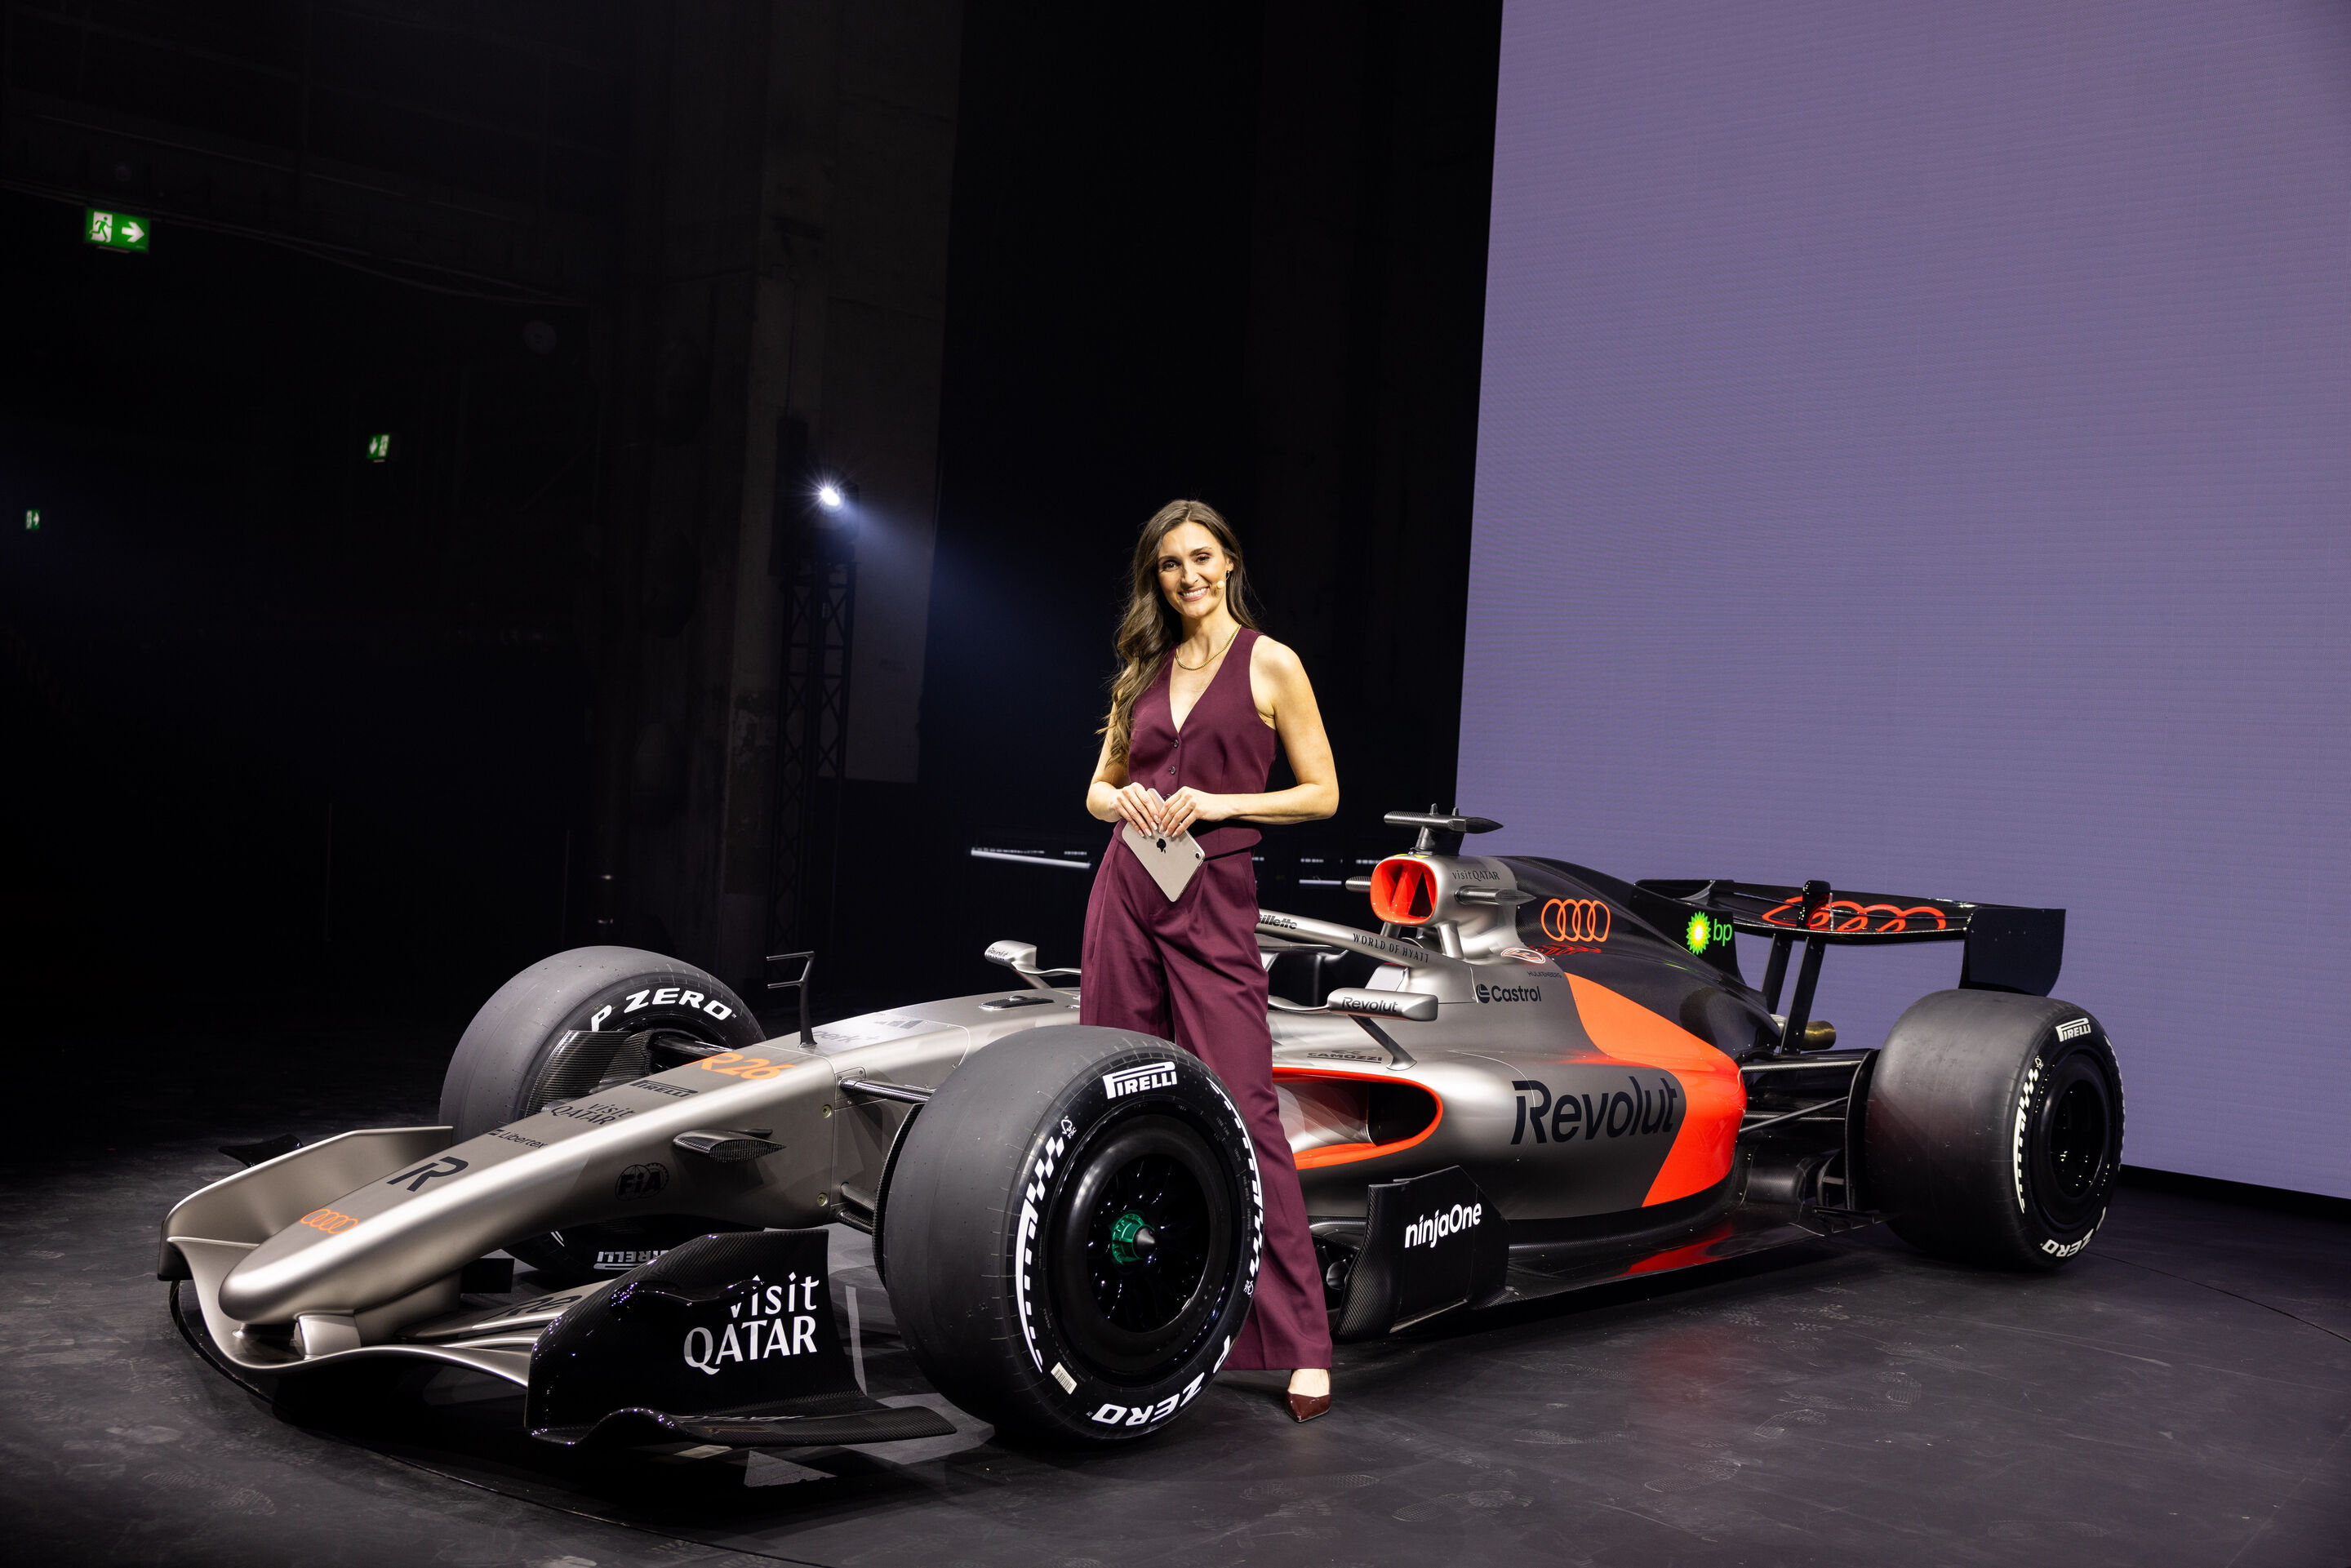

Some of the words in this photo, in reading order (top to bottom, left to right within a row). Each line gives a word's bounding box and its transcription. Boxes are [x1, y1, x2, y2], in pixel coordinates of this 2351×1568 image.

[1260, 913, 1297, 930] illette
[1713, 918, 1733, 947] bp
[1353, 933, 1386, 950] WORLD
[1389, 943, 1399, 954] OF
[1402, 947, 1429, 963] HYATT
[1341, 997, 1398, 1012] Revolut
[1491, 985, 1542, 1002] Castrol
[591, 1005, 612, 1032] P
[624, 988, 732, 1020] ZERO
[2055, 1017, 2091, 1042] PIRELLI
[686, 1051, 798, 1080] R26
[1308, 1052, 1383, 1062] CAMOZZI
[629, 1079, 699, 1098] PIRELLI
[1102, 1061, 1178, 1099] PIRELLI
[551, 1105, 616, 1126] QATAR
[587, 1103, 637, 1117] visit
[1510, 1076, 1678, 1145] Revolut
[498, 1130, 549, 1149] Libertex
[386, 1157, 469, 1193] R
[1404, 1202, 1482, 1248] ninjaOne
[2042, 1228, 2094, 1257] ZERO
[683, 1315, 818, 1375] QATAR
[1091, 1372, 1205, 1426] ZERO
